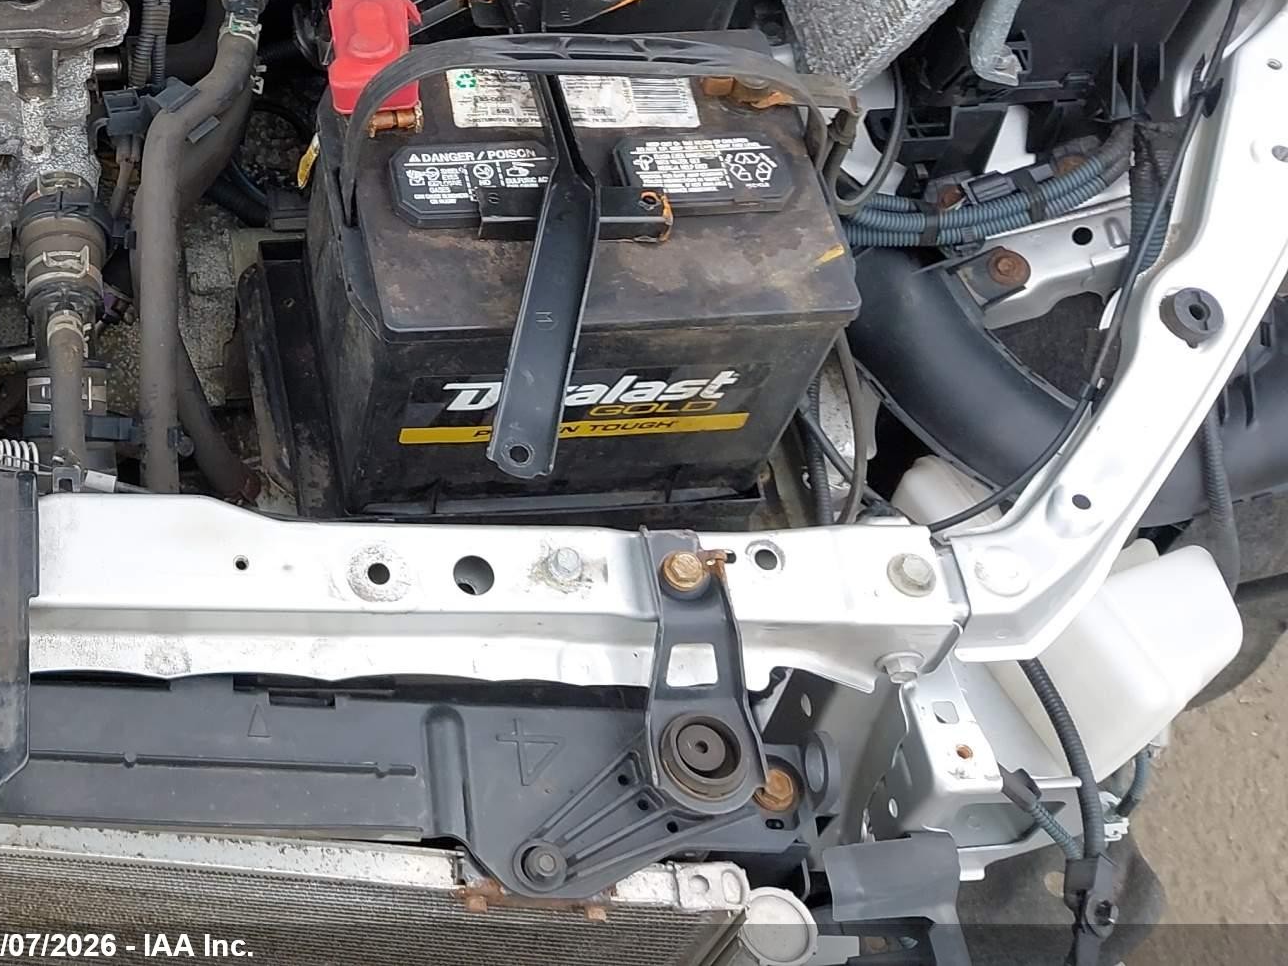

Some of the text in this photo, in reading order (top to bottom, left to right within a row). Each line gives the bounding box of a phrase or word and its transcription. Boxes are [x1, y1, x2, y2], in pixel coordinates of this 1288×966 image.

[421, 151, 475, 163] DANGER
[486, 148, 536, 160] POISON
[443, 370, 740, 412] Dalast
[589, 400, 717, 418] GOLD
[590, 420, 673, 434] TOUGH
